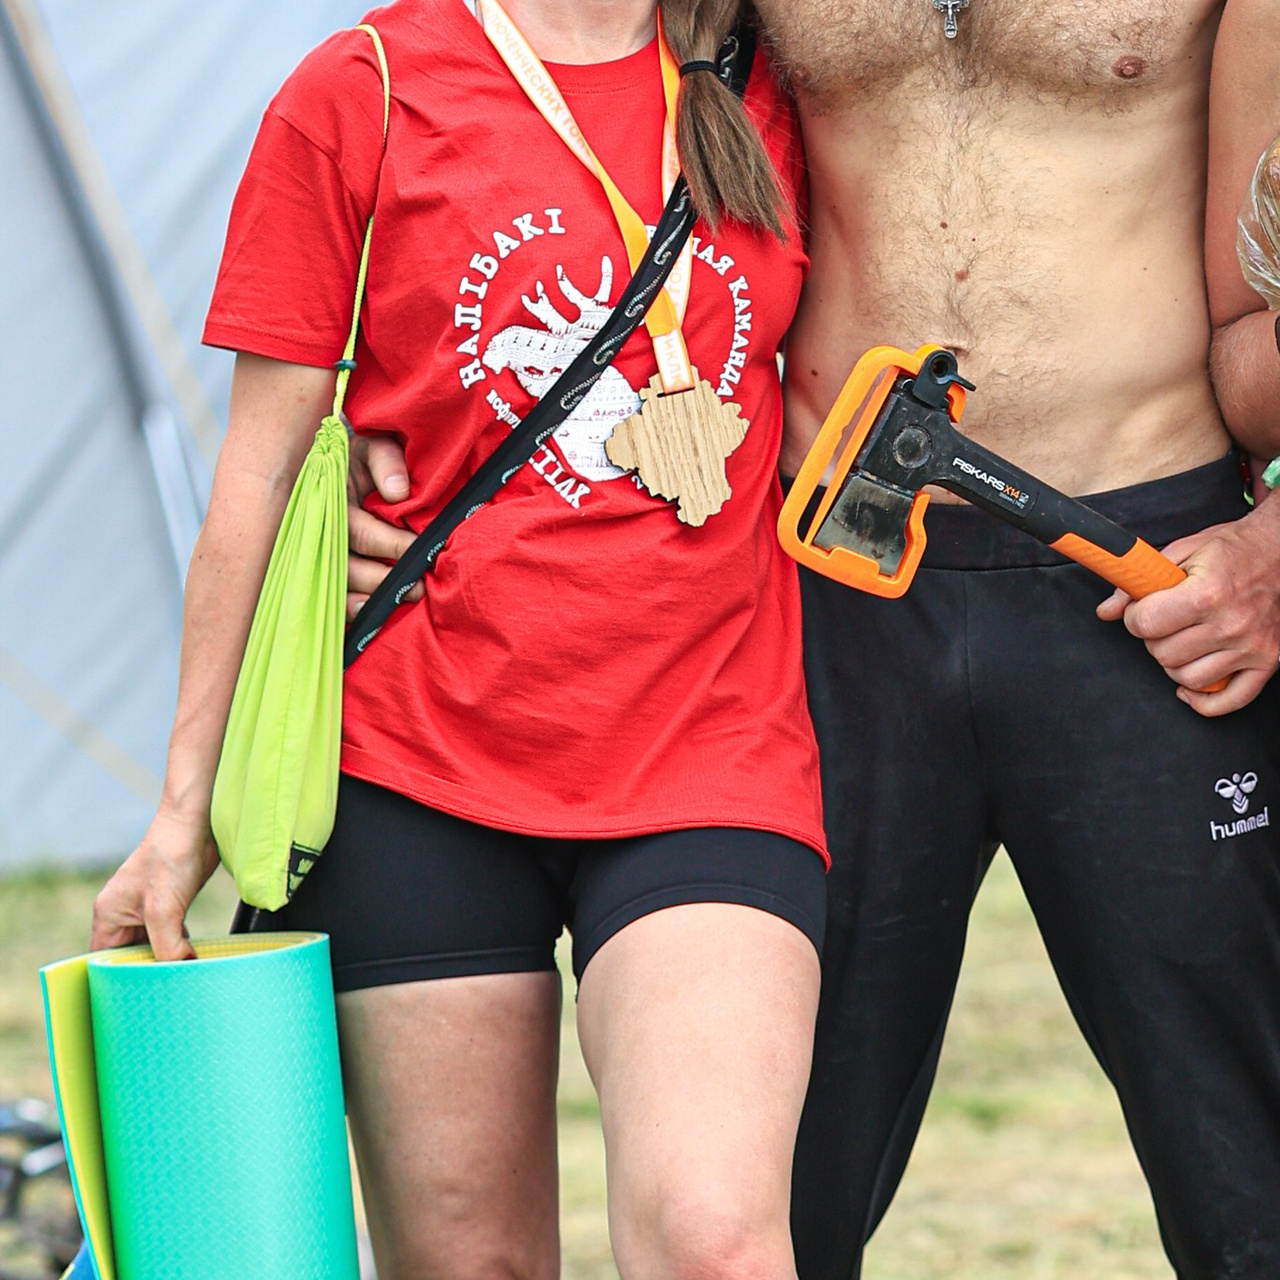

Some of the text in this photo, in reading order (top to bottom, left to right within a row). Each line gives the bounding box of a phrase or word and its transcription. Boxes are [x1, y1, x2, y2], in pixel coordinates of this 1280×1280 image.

[716, 274, 753, 397] КАМАНДА
[952, 457, 1020, 499] FISKARS X14
[1210, 806, 1270, 841] hummel
